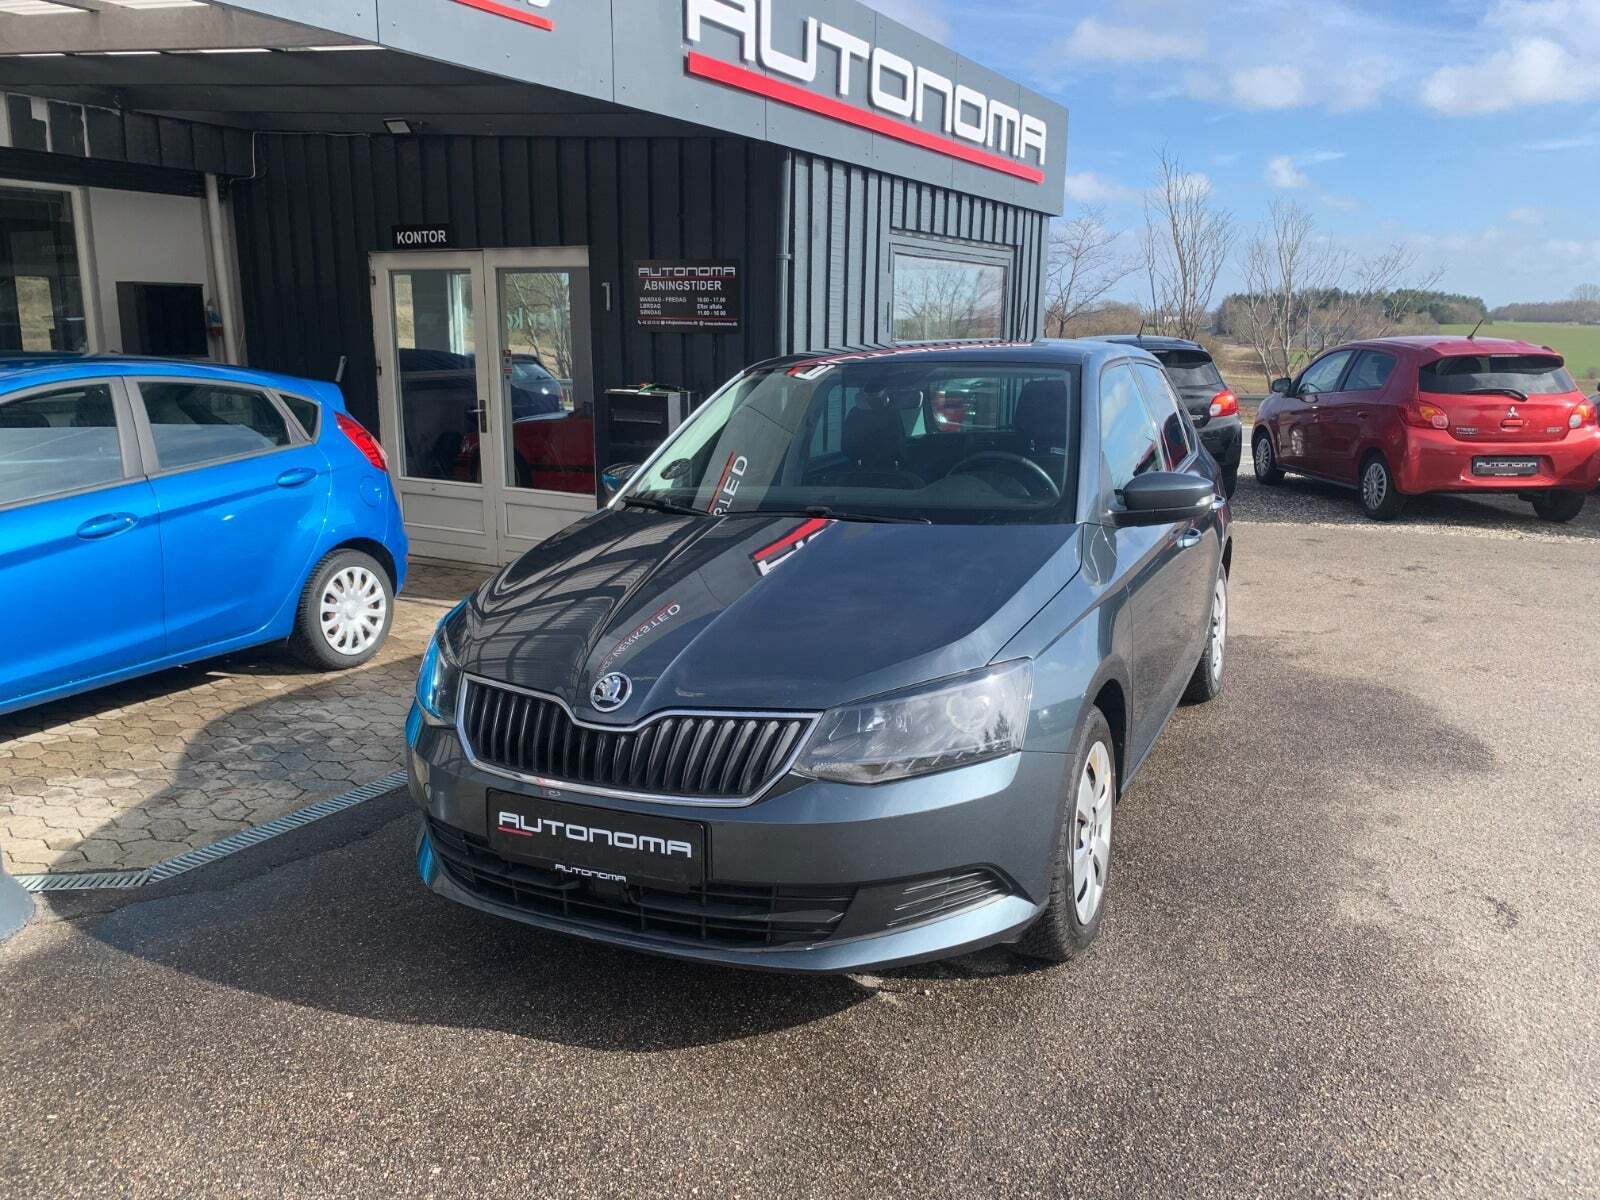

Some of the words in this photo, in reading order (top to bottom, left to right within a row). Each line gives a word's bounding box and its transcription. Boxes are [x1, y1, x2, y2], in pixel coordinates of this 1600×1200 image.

[687, 0, 1047, 165] AUTONOMA
[396, 229, 447, 245] KONTOR
[638, 266, 736, 277] AUTONOMA
[644, 279, 722, 291] ÅBNINGSTIDER
[1476, 461, 1537, 469] AUTONOMA
[498, 811, 692, 858] AUTONOMA
[554, 863, 627, 883] AUTONOMA
